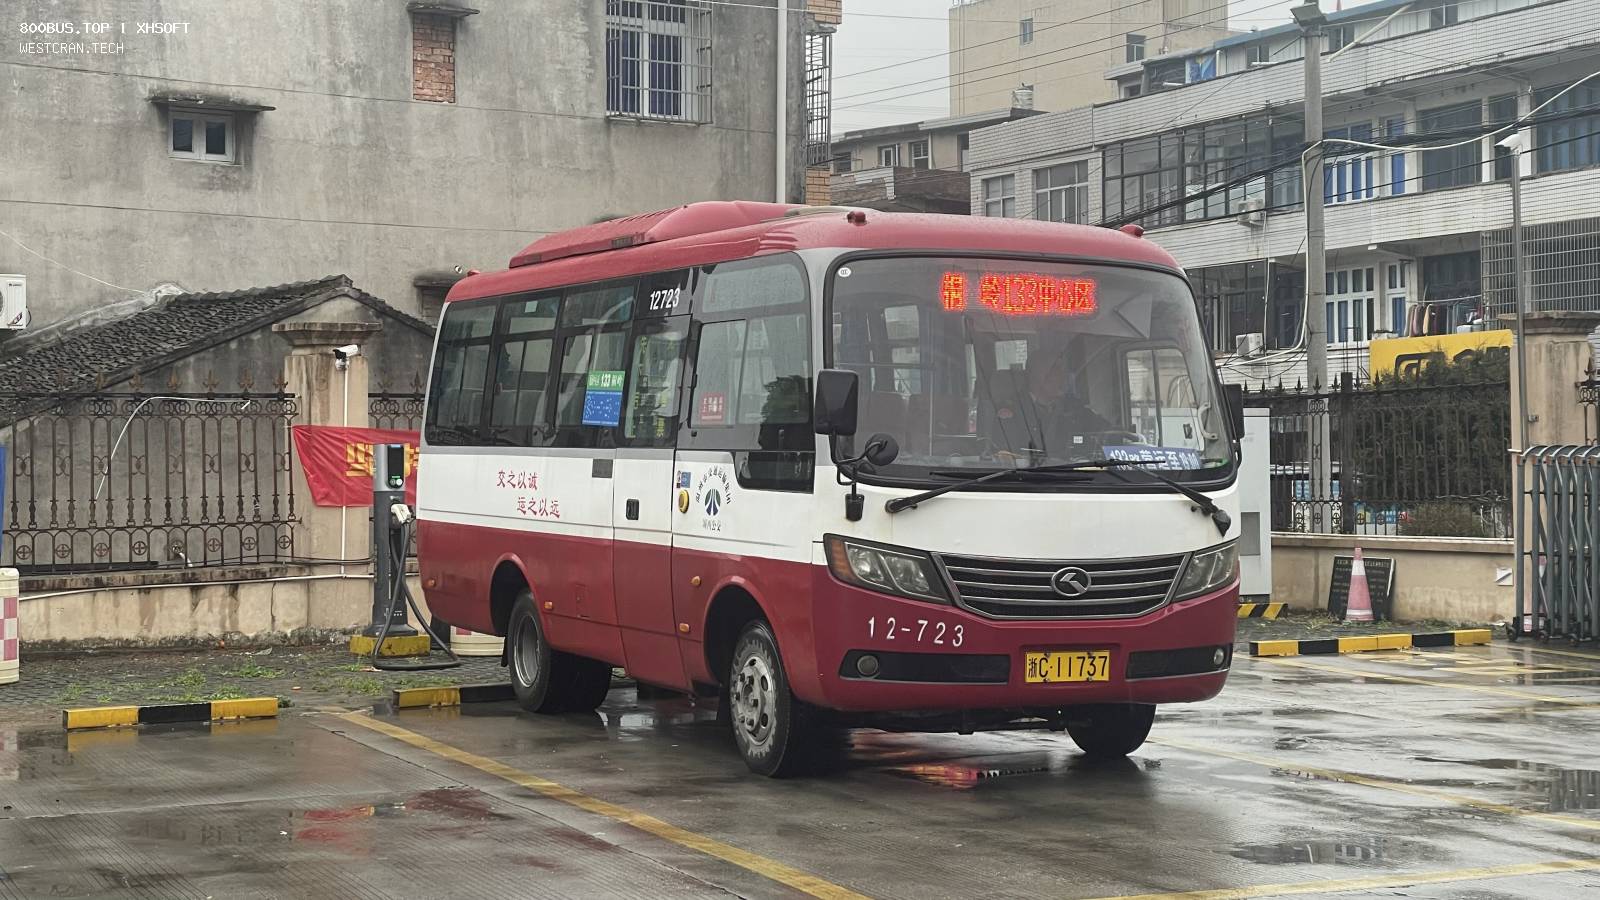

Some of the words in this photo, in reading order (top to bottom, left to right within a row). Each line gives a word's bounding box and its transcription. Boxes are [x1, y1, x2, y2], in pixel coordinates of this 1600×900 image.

[650, 287, 680, 310] 12723
[496, 469, 538, 491] 交之以诚
[516, 496, 560, 518] 运之以远
[868, 616, 964, 647] 12-723
